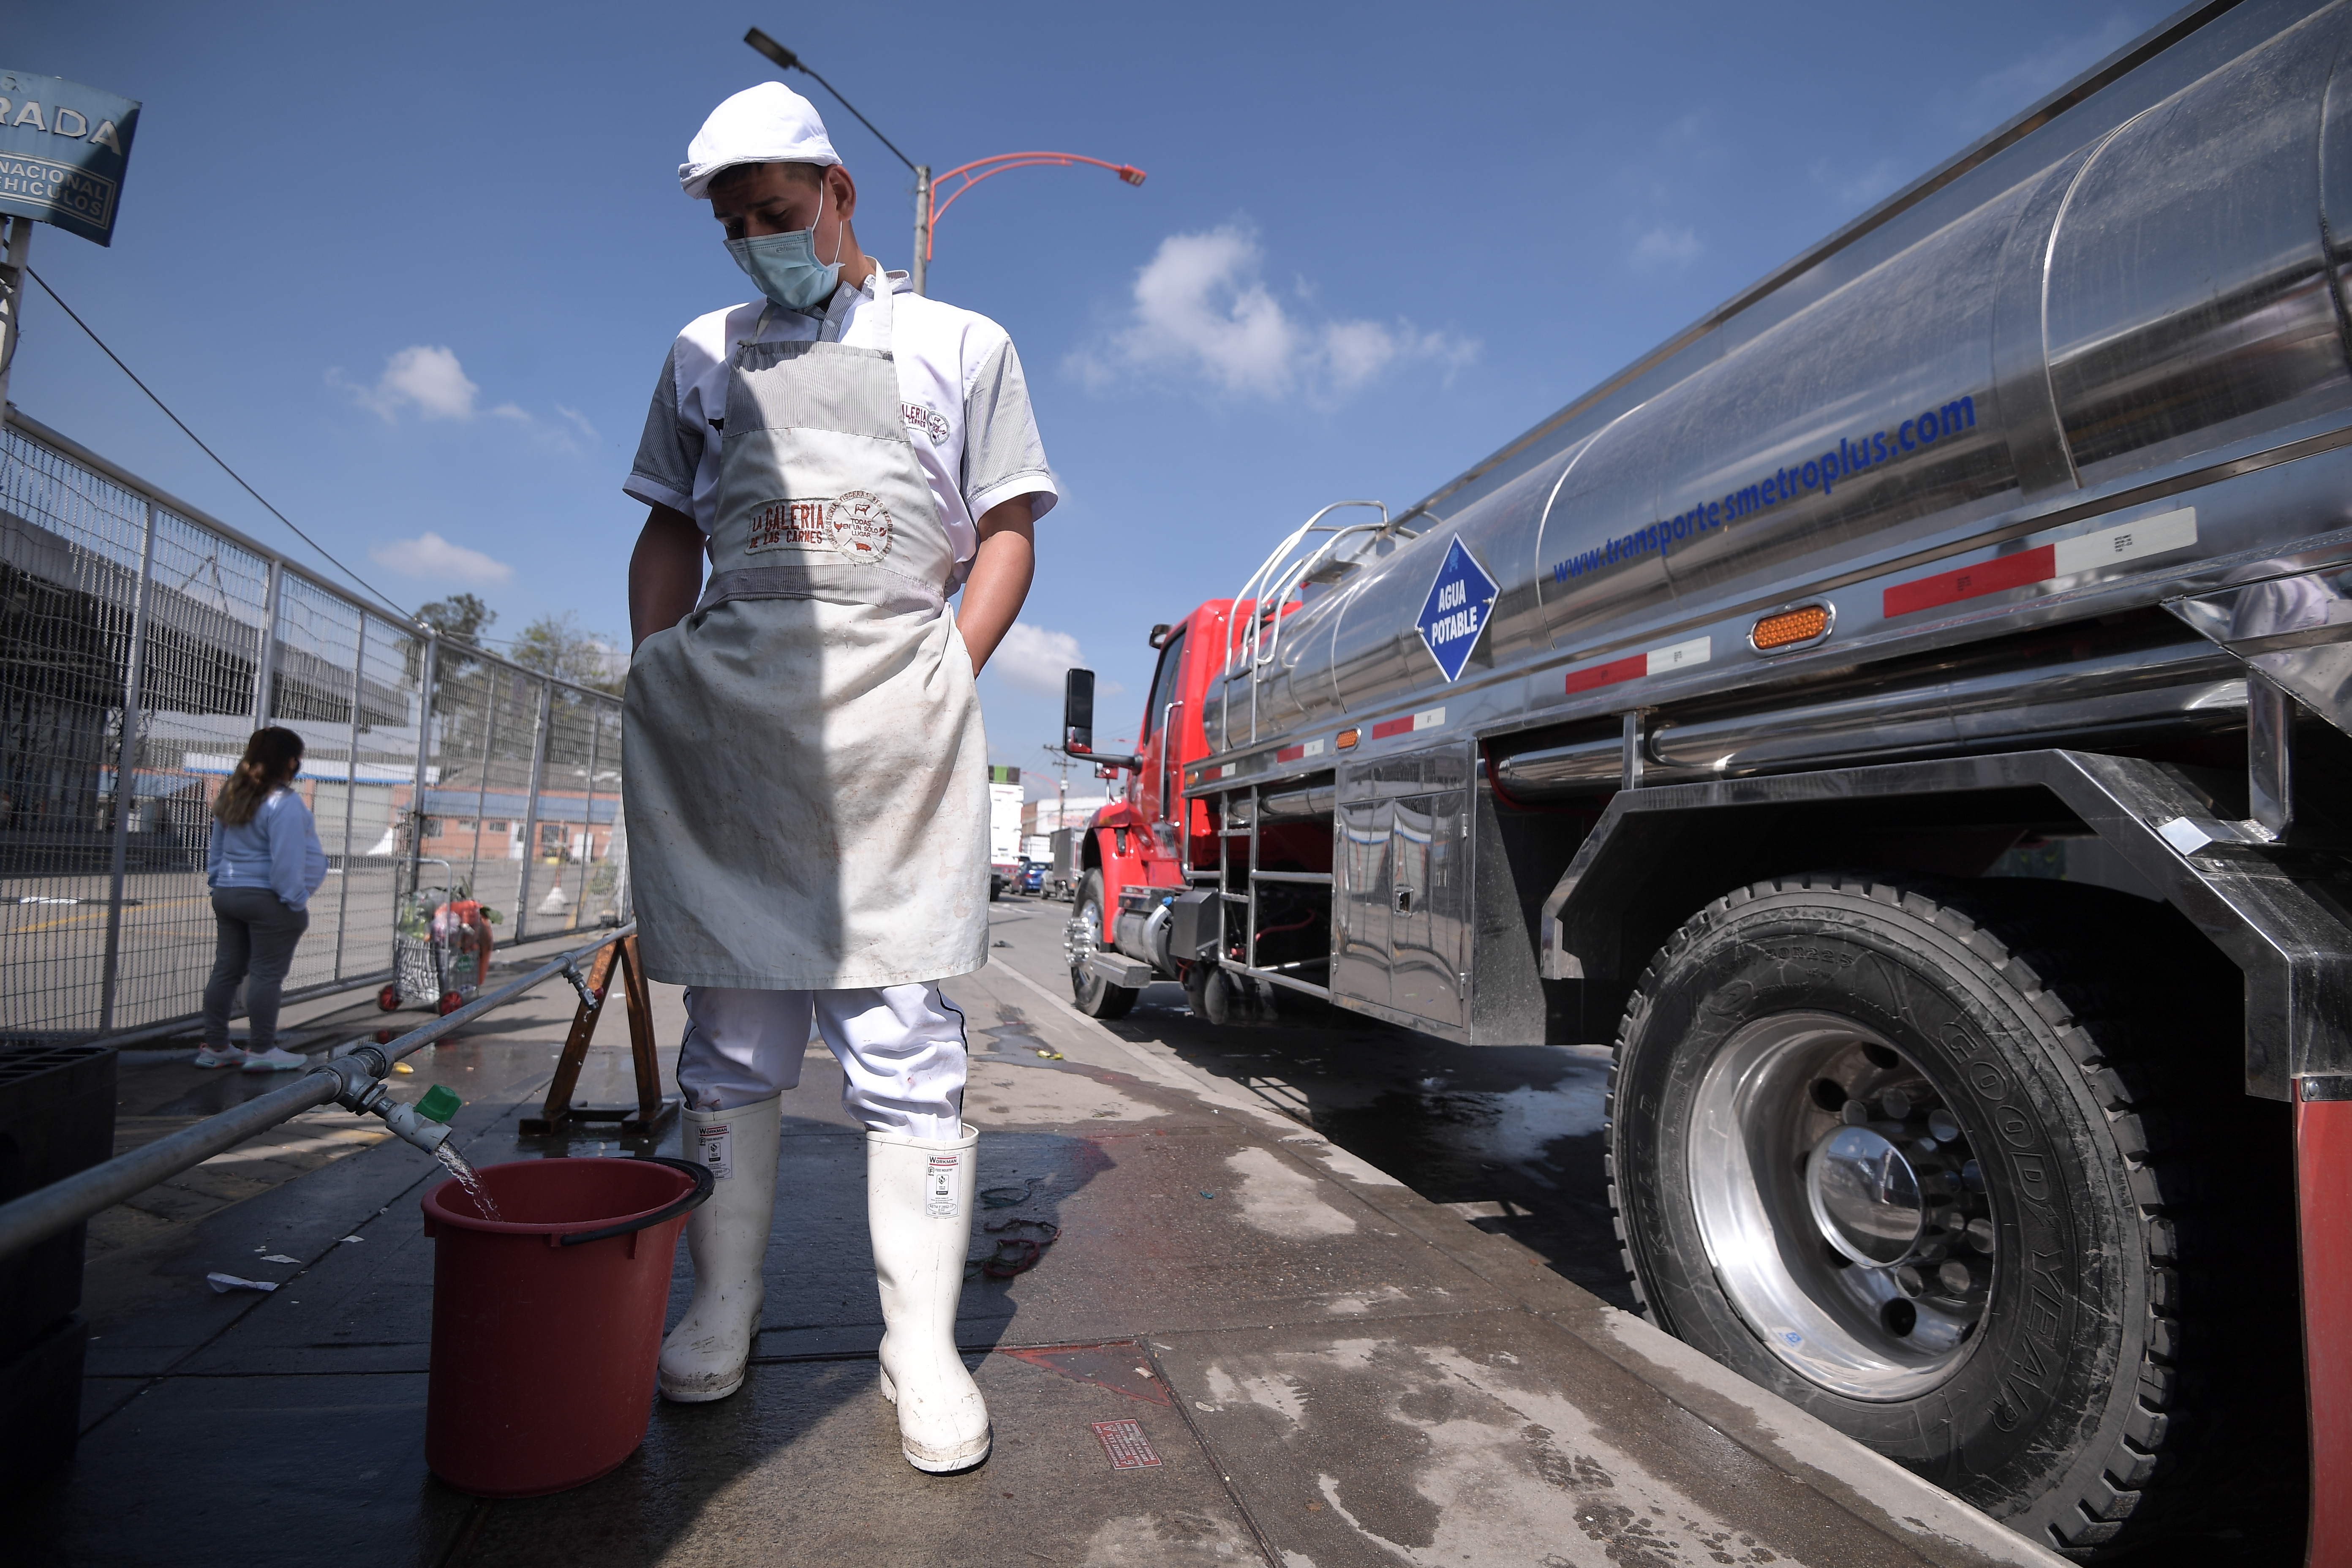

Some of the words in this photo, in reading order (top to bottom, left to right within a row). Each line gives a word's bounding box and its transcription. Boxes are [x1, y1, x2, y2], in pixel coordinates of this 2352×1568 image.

[0, 161, 103, 200] NACIONAL
[0, 176, 102, 216] HICULOS
[752, 517, 762, 532] LA
[765, 504, 824, 532] GALERIA
[872, 497, 883, 508] RES
[850, 518, 871, 526] TODAS
[749, 537, 759, 549] DE
[763, 531, 780, 545] LAS
[786, 530, 823, 544] CARNES
[1438, 579, 1466, 613] AGUA
[1432, 606, 1478, 647] POTABLE
[1939, 1021, 2064, 1434] GOODYEAR
